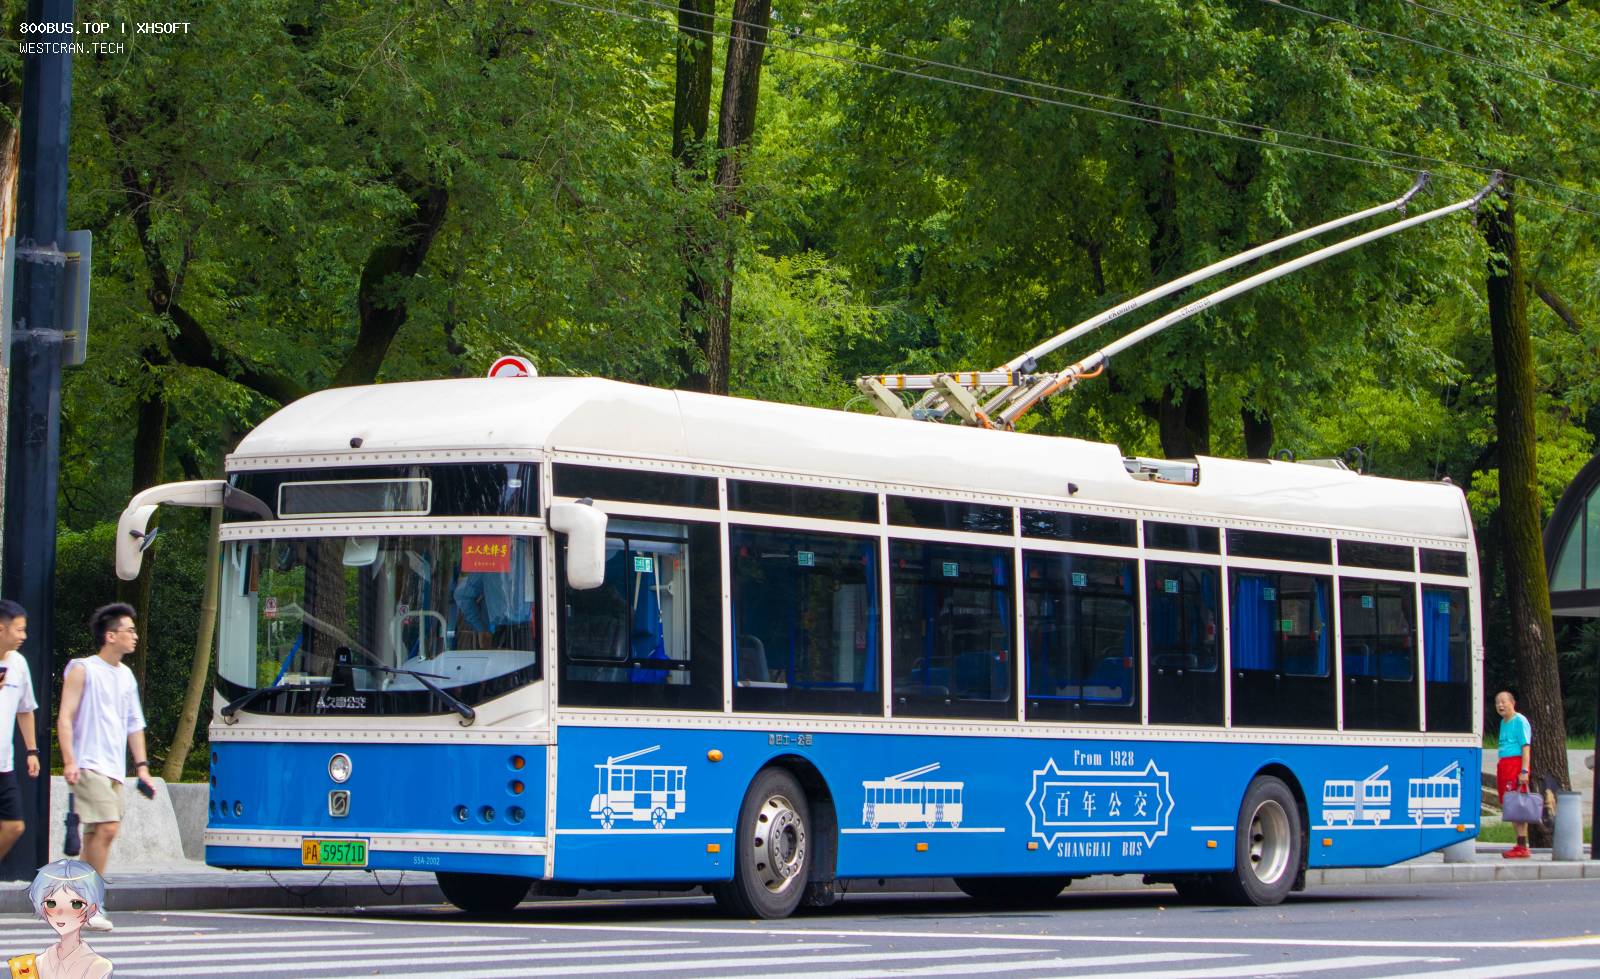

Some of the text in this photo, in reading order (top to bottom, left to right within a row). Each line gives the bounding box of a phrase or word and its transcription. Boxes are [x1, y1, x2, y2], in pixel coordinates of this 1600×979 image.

[1073, 749, 1135, 767] From 1928
[1055, 790, 1149, 818] 百年公交
[1056, 841, 1143, 858] SHANGHAI BUS
